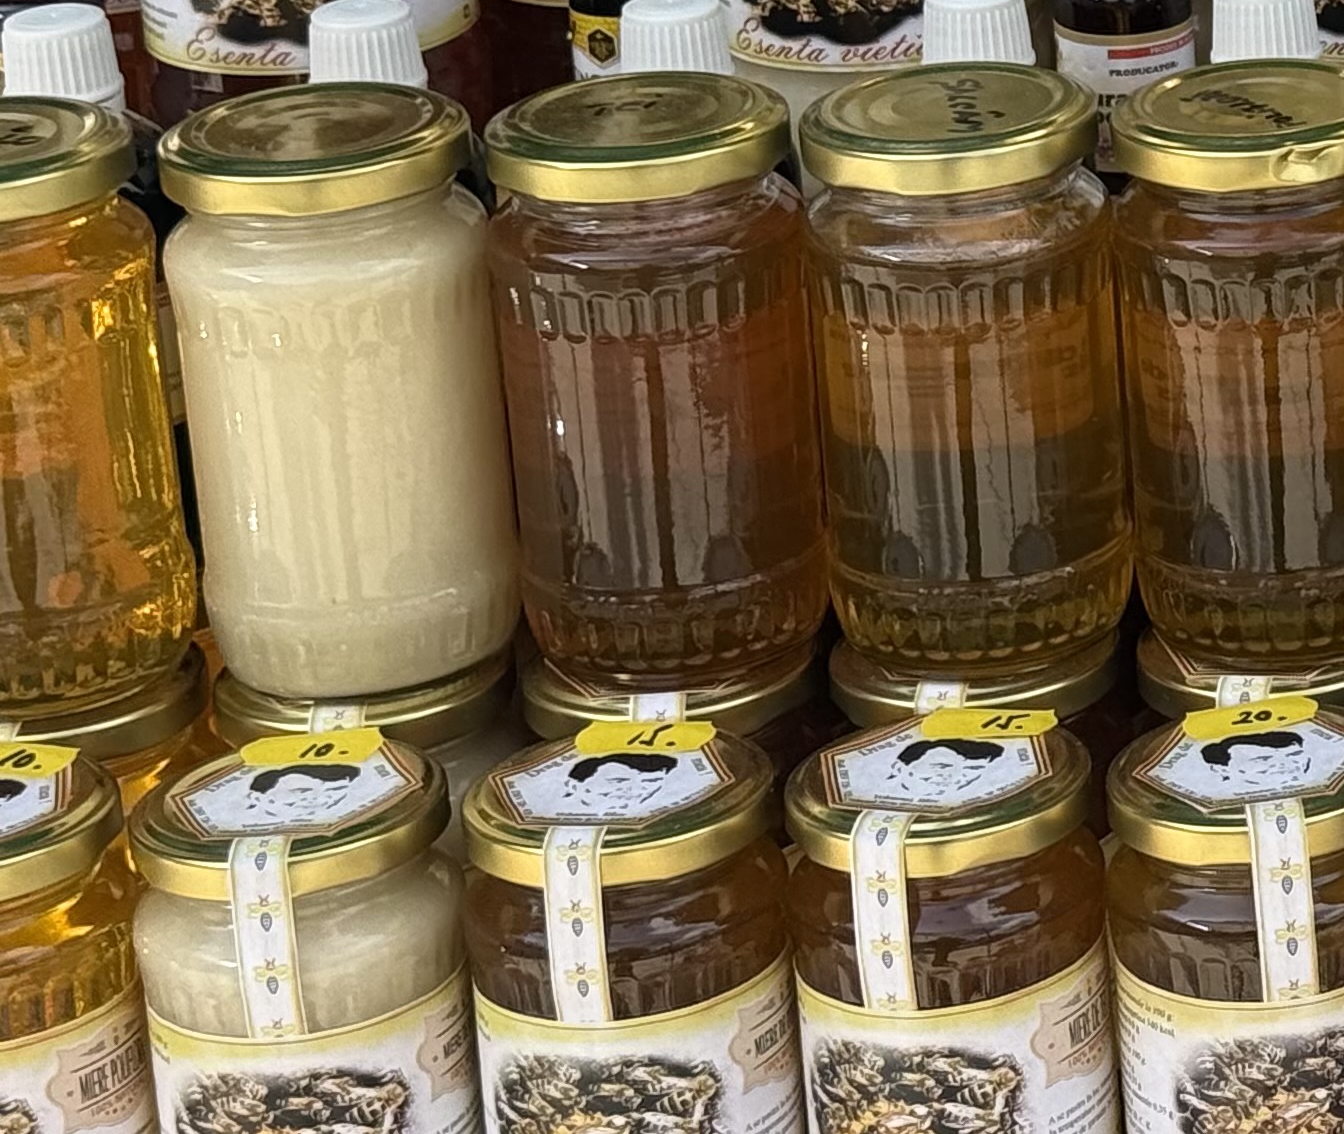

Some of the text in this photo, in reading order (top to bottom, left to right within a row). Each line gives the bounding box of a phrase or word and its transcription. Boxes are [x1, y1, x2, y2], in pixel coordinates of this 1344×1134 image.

[185, 27, 296, 66] Esenta
[736, 17, 830, 64] Esenta
[78, 1063, 111, 1104] MIERE
